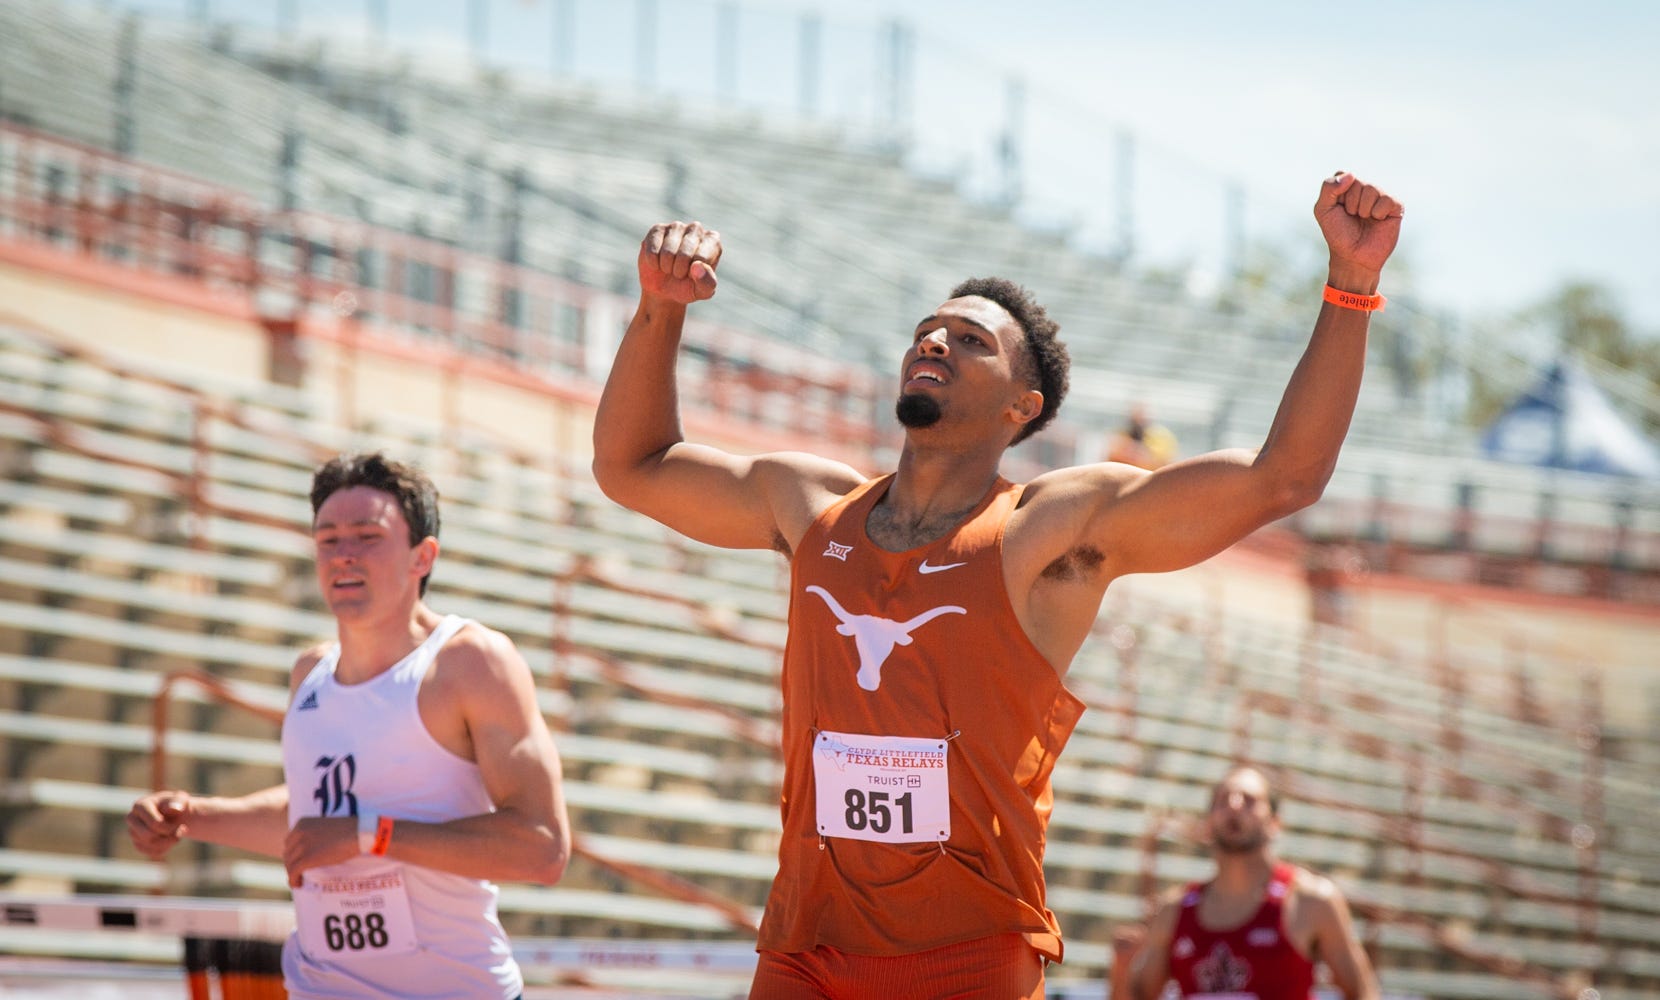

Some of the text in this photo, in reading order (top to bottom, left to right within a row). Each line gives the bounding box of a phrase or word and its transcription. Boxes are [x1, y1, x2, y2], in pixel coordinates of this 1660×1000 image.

[846, 753, 944, 769] TEXAS RELAYS
[880, 749, 944, 758] LITTLEFIELD
[867, 775, 904, 786] TRUIST
[844, 788, 914, 834] 851
[324, 913, 389, 951] 688
